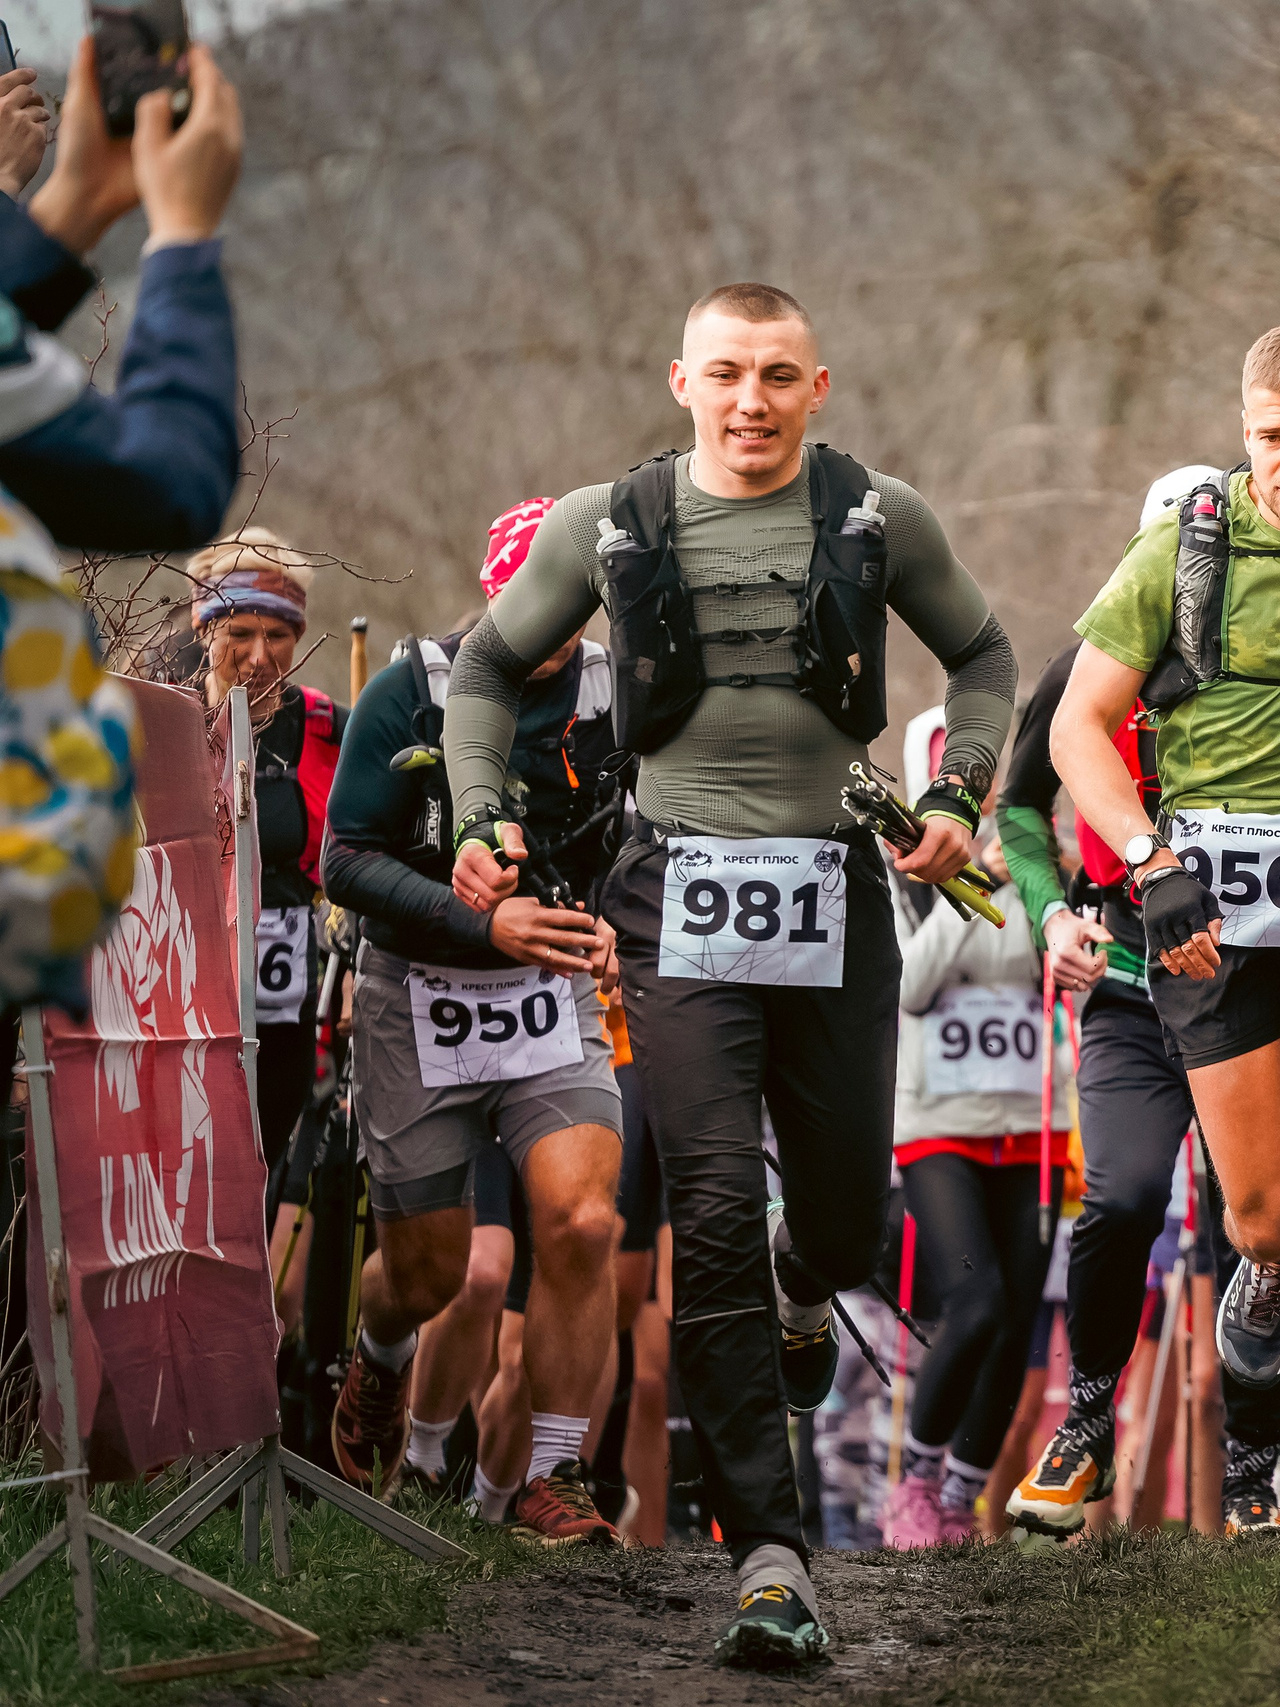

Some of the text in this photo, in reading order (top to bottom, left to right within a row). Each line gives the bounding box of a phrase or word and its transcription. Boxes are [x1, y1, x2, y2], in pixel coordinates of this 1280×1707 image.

[1211, 823, 1280, 838] КРЕСТ ПЛЮС
[723, 855, 799, 865] КРЕСТ ПЛЮС
[681, 878, 828, 944] 981
[461, 978, 526, 991] КРЕСТ ПЛЮС
[429, 989, 559, 1047] 950
[941, 1019, 1037, 1060] 960
